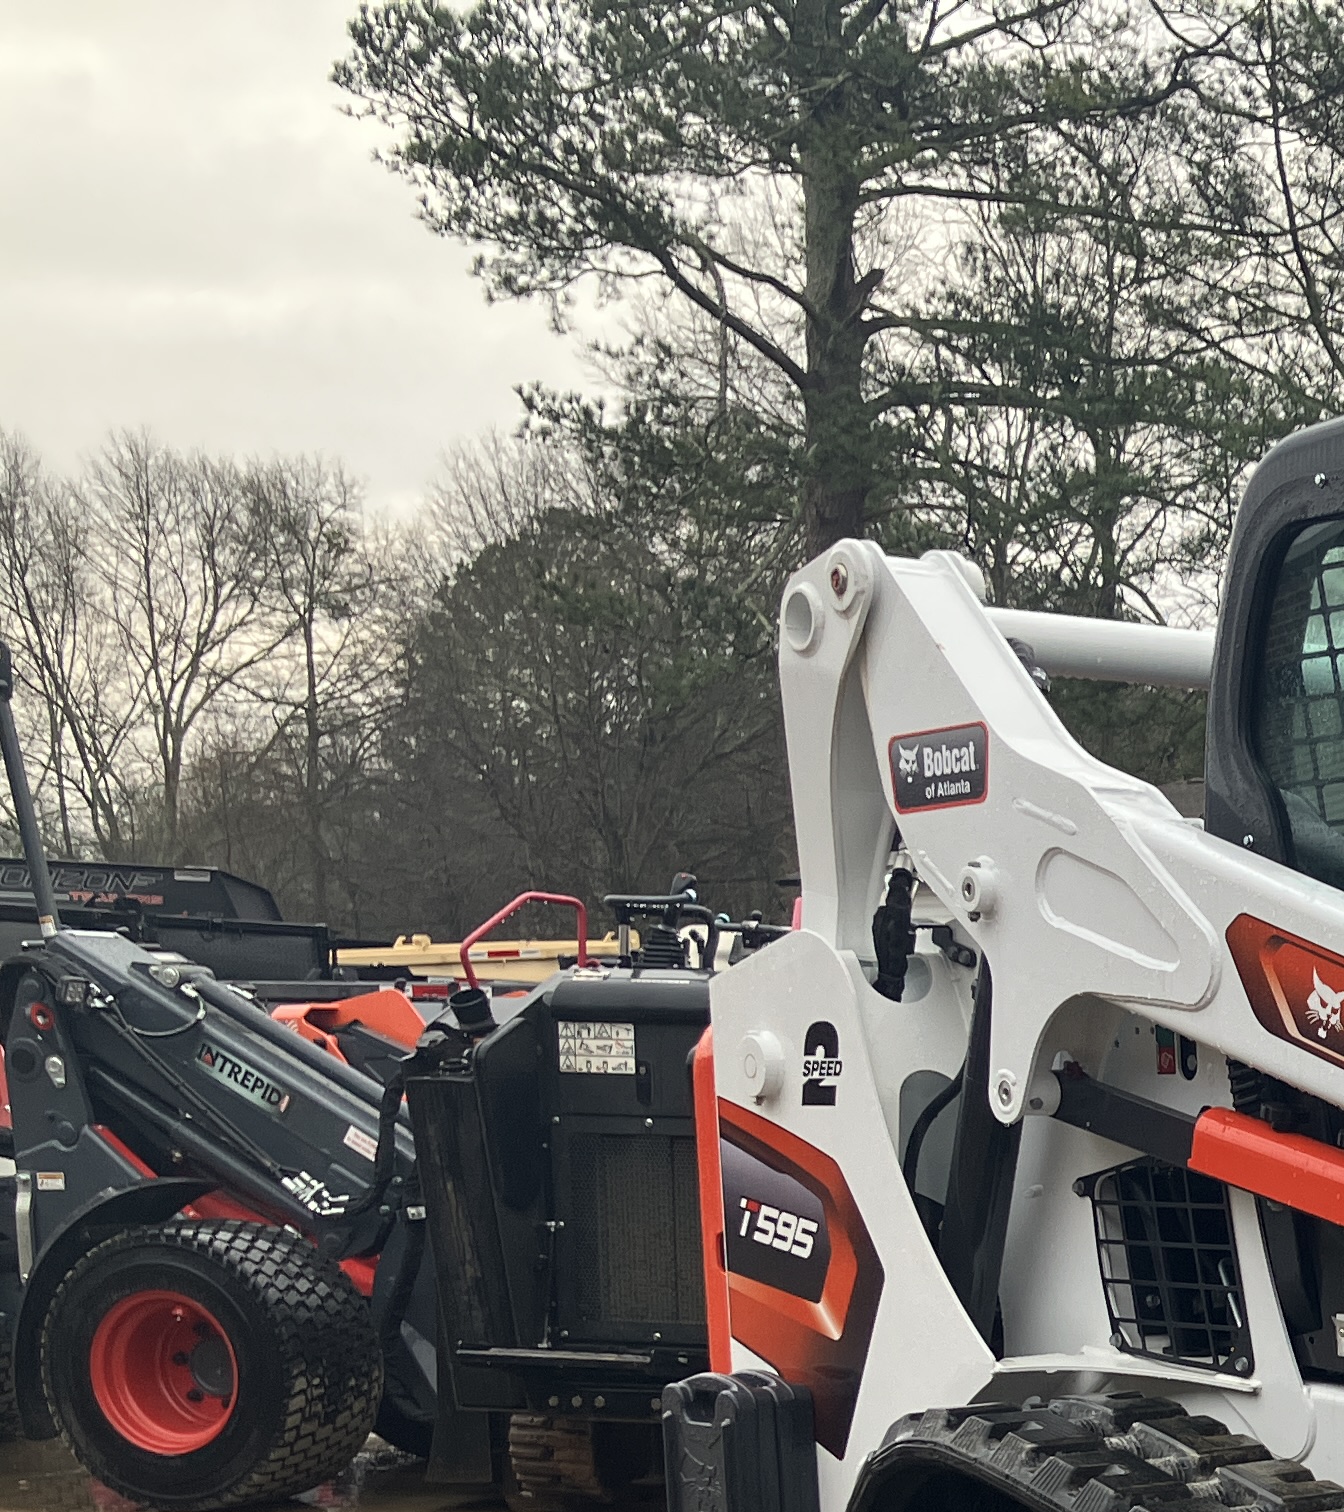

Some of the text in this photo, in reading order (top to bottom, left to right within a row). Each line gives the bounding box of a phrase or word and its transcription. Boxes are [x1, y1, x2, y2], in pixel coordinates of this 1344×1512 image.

[923, 741, 977, 778] Bobcat
[925, 779, 970, 799] of Atlanta
[199, 1042, 284, 1106] INTREPID
[802, 1020, 839, 1106] 2
[802, 1060, 842, 1079] SPEED
[739, 1197, 818, 1259] T595
